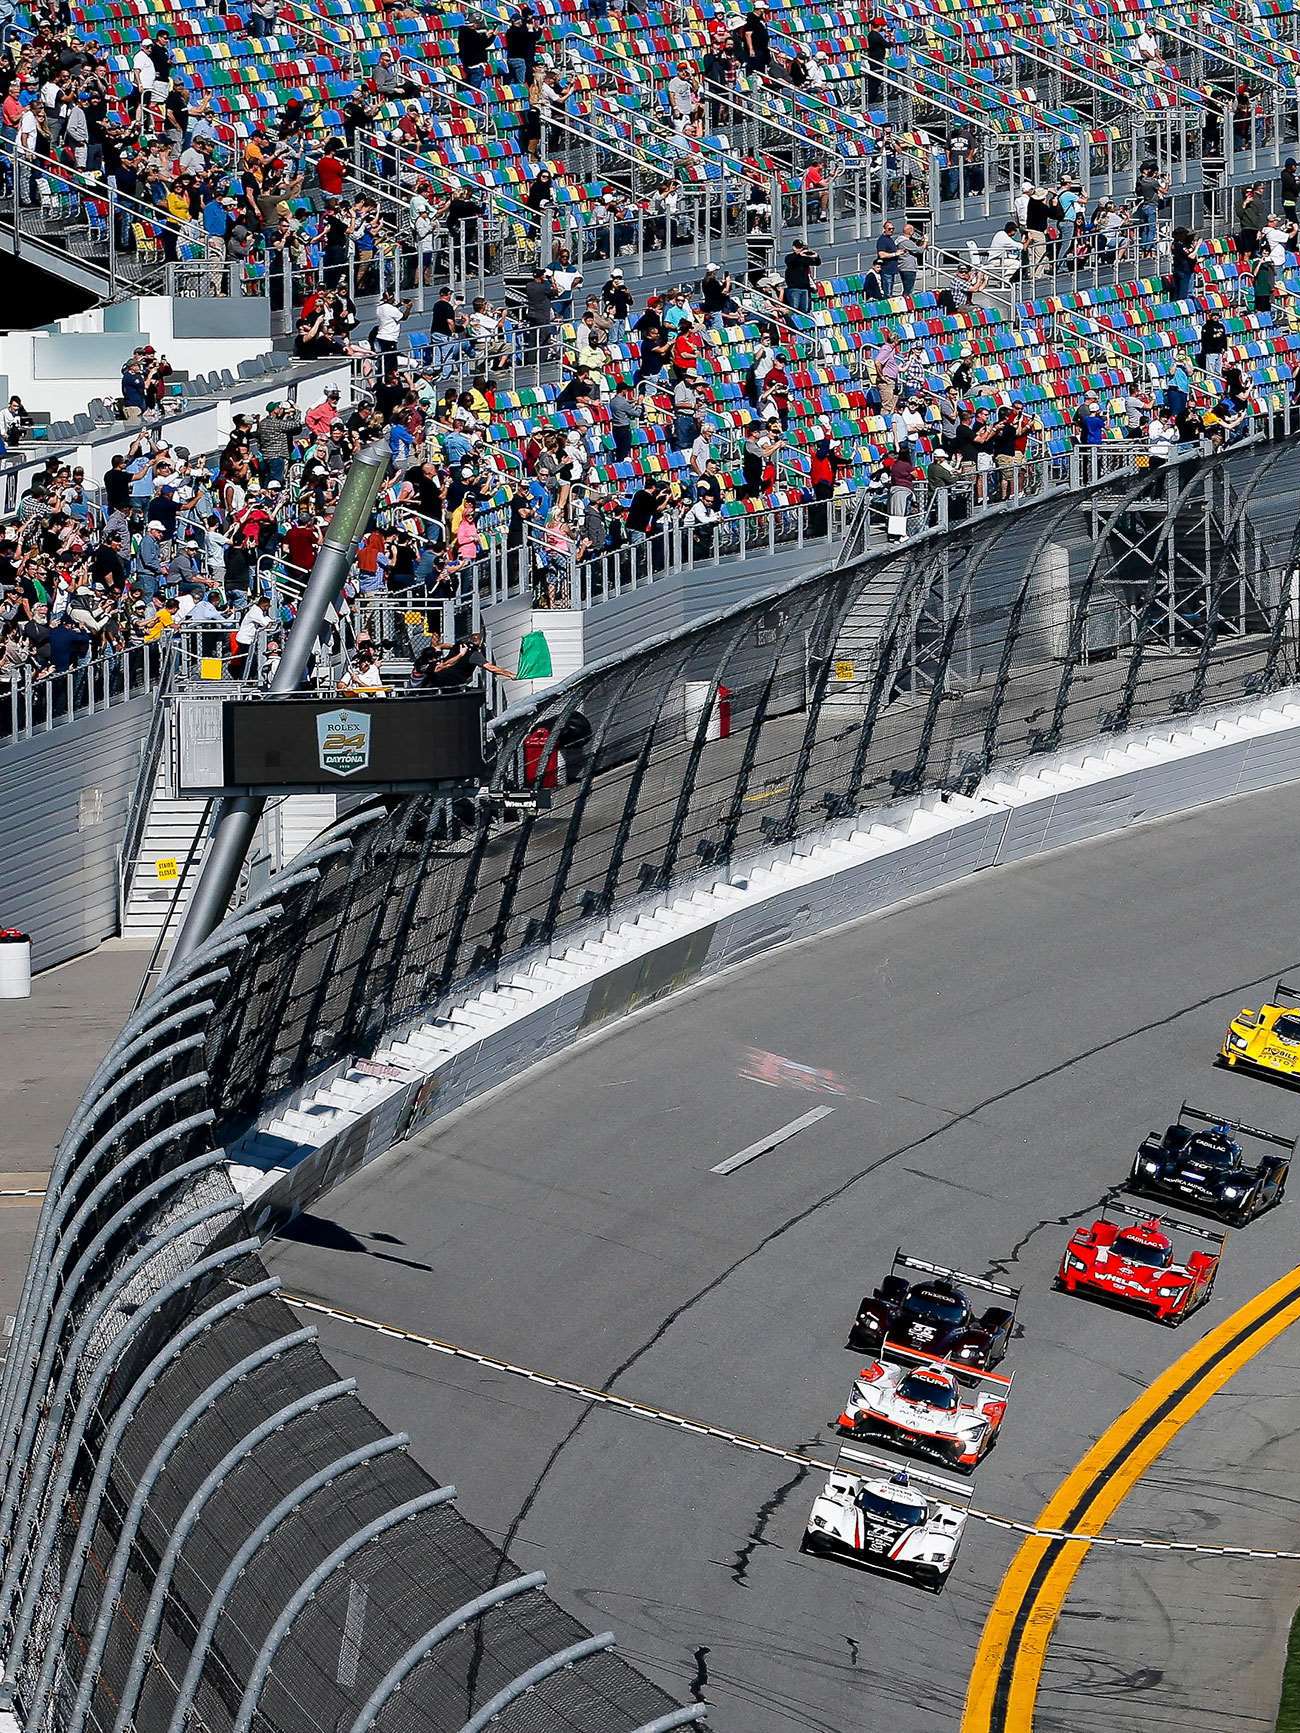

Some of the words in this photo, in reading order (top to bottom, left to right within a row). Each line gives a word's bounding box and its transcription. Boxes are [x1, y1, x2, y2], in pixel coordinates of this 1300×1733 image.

[327, 723, 361, 732] ROLEX
[322, 733, 367, 750] 24
[325, 755, 363, 763] DAYTONA
[1195, 1138, 1226, 1152] CADILLAC
[1126, 1233, 1158, 1247] CADILLAC
[1094, 1271, 1152, 1294] WHELEN
[911, 1373, 950, 1389] ACURA
